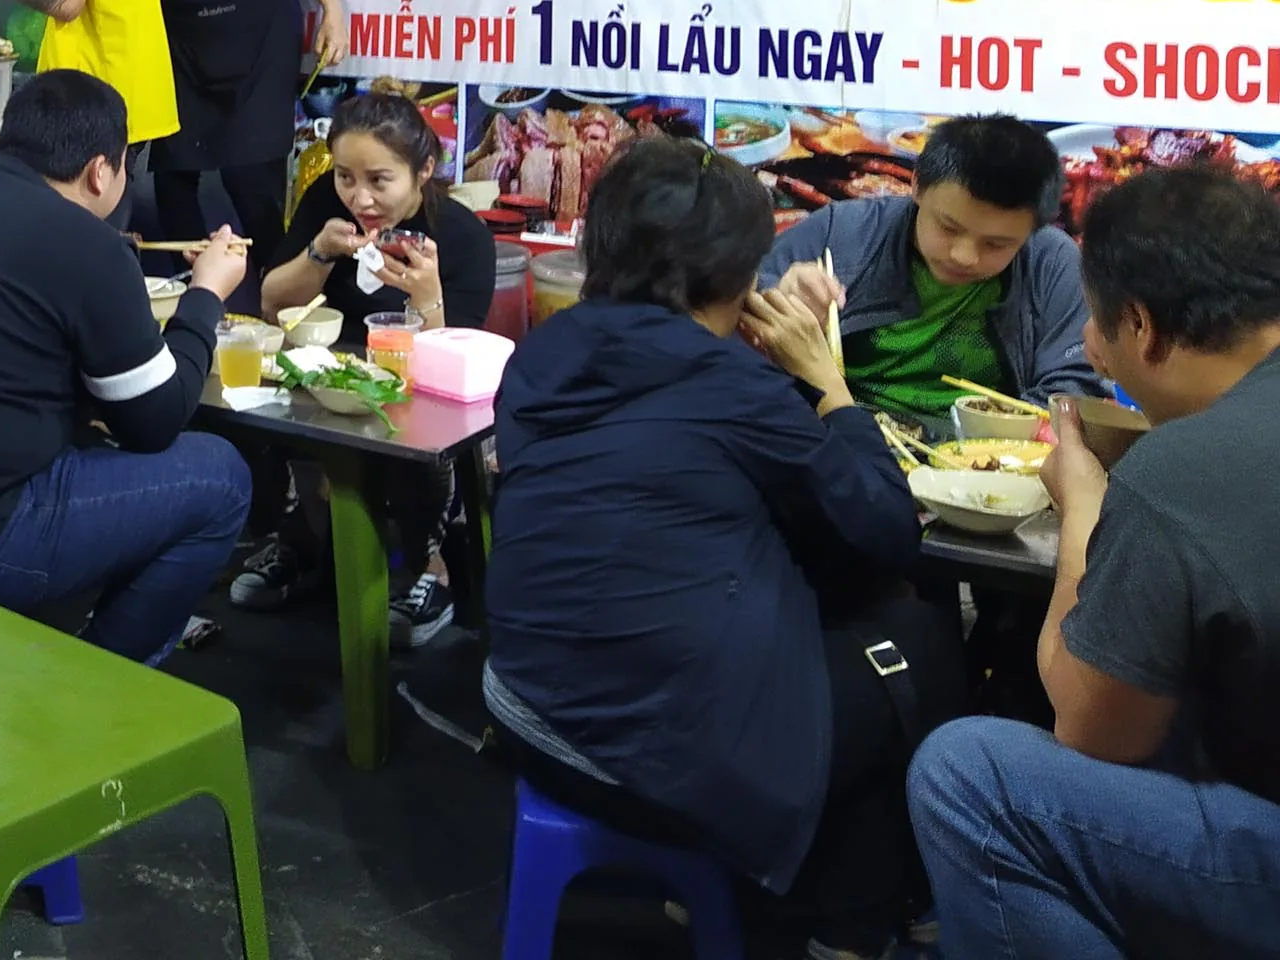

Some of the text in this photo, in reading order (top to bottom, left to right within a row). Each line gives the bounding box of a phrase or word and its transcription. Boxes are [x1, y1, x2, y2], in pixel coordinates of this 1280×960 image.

[454, 7, 516, 64] PHÍ
[531, 0, 553, 65] 1
[571, 3, 641, 70] NỒI
[656, 3, 741, 76] LẨU
[758, 27, 884, 84] NGAY
[940, 34, 1043, 93] HOT
